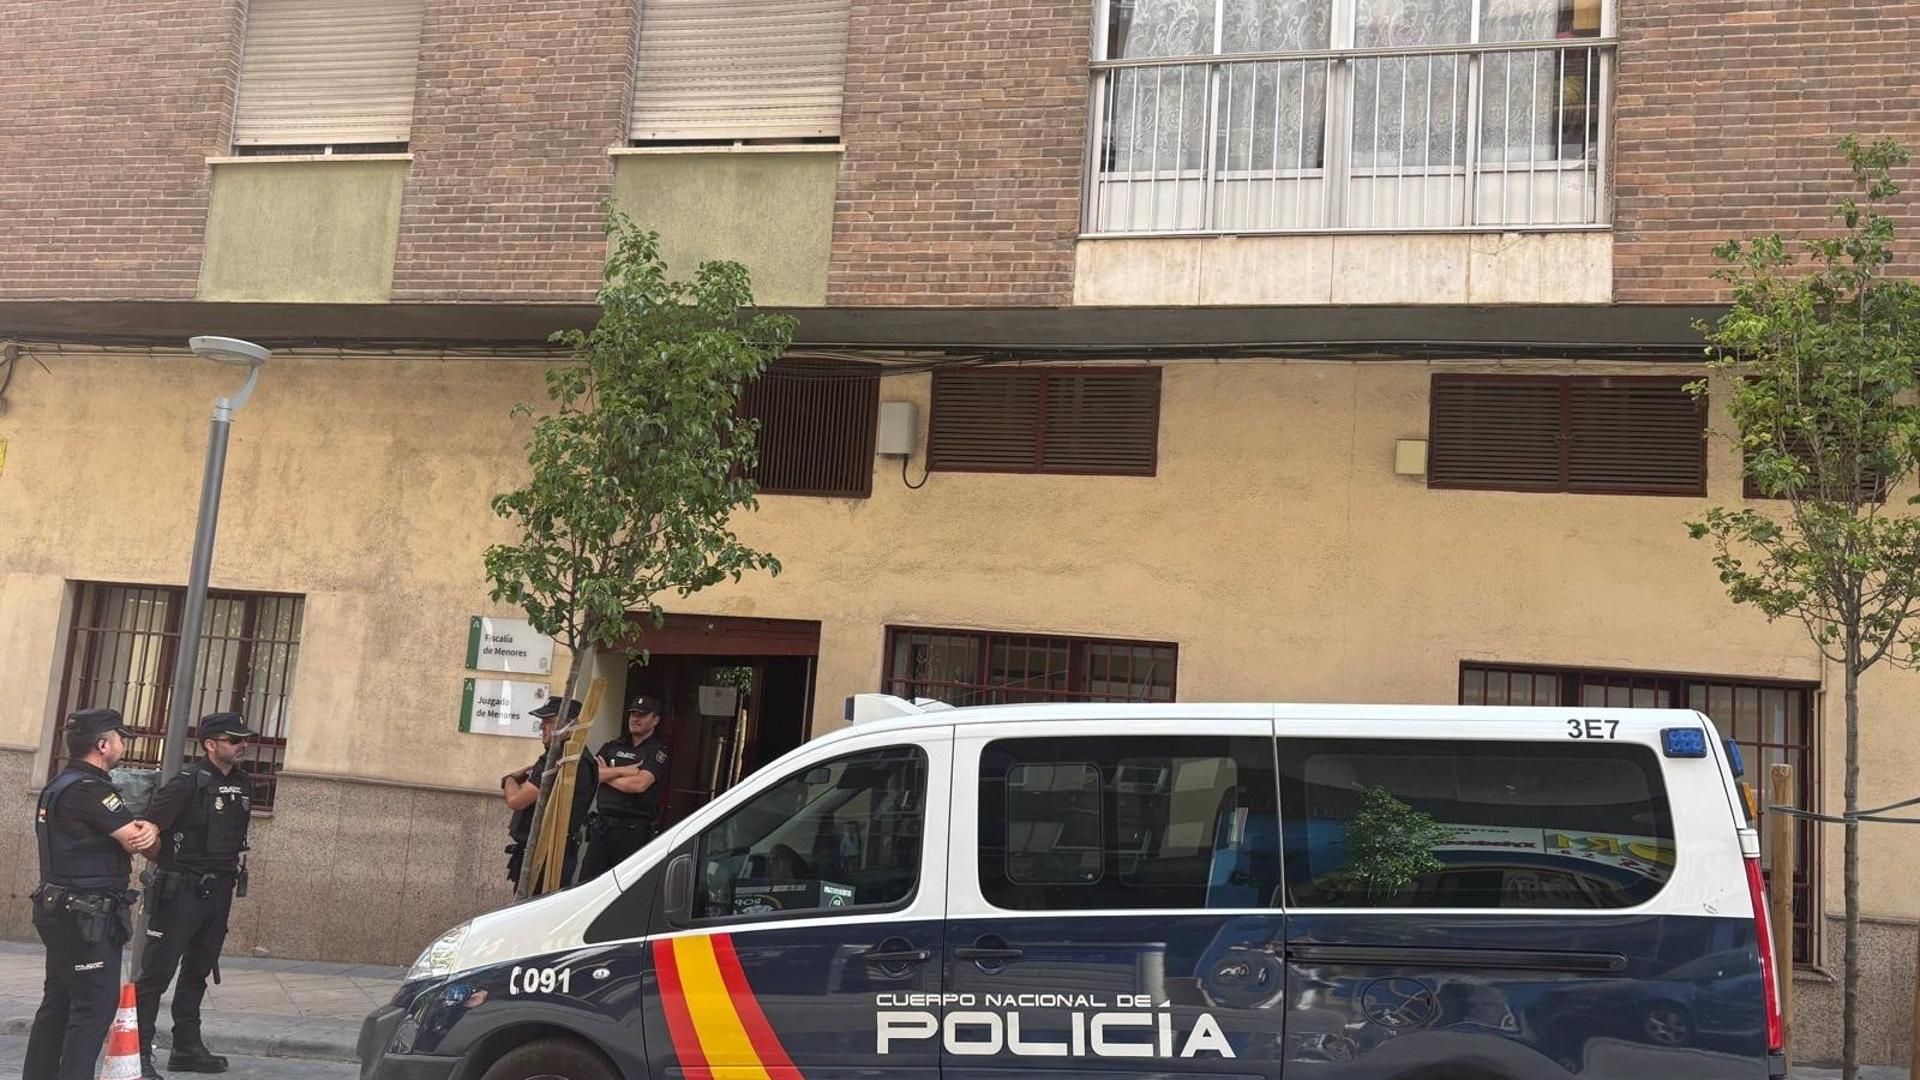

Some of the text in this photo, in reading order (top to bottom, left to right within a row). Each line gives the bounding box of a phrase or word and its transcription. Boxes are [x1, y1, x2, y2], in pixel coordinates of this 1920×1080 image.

[482, 647, 527, 657] de Menores
[478, 696, 510, 707] Juzgado
[476, 709, 521, 720] de Menores
[1566, 718, 1620, 739] 3E7
[523, 967, 571, 993] 091
[876, 993, 1152, 1008] CUERPO NACIONAL DE
[876, 1000, 1237, 1058] POLICÍA
